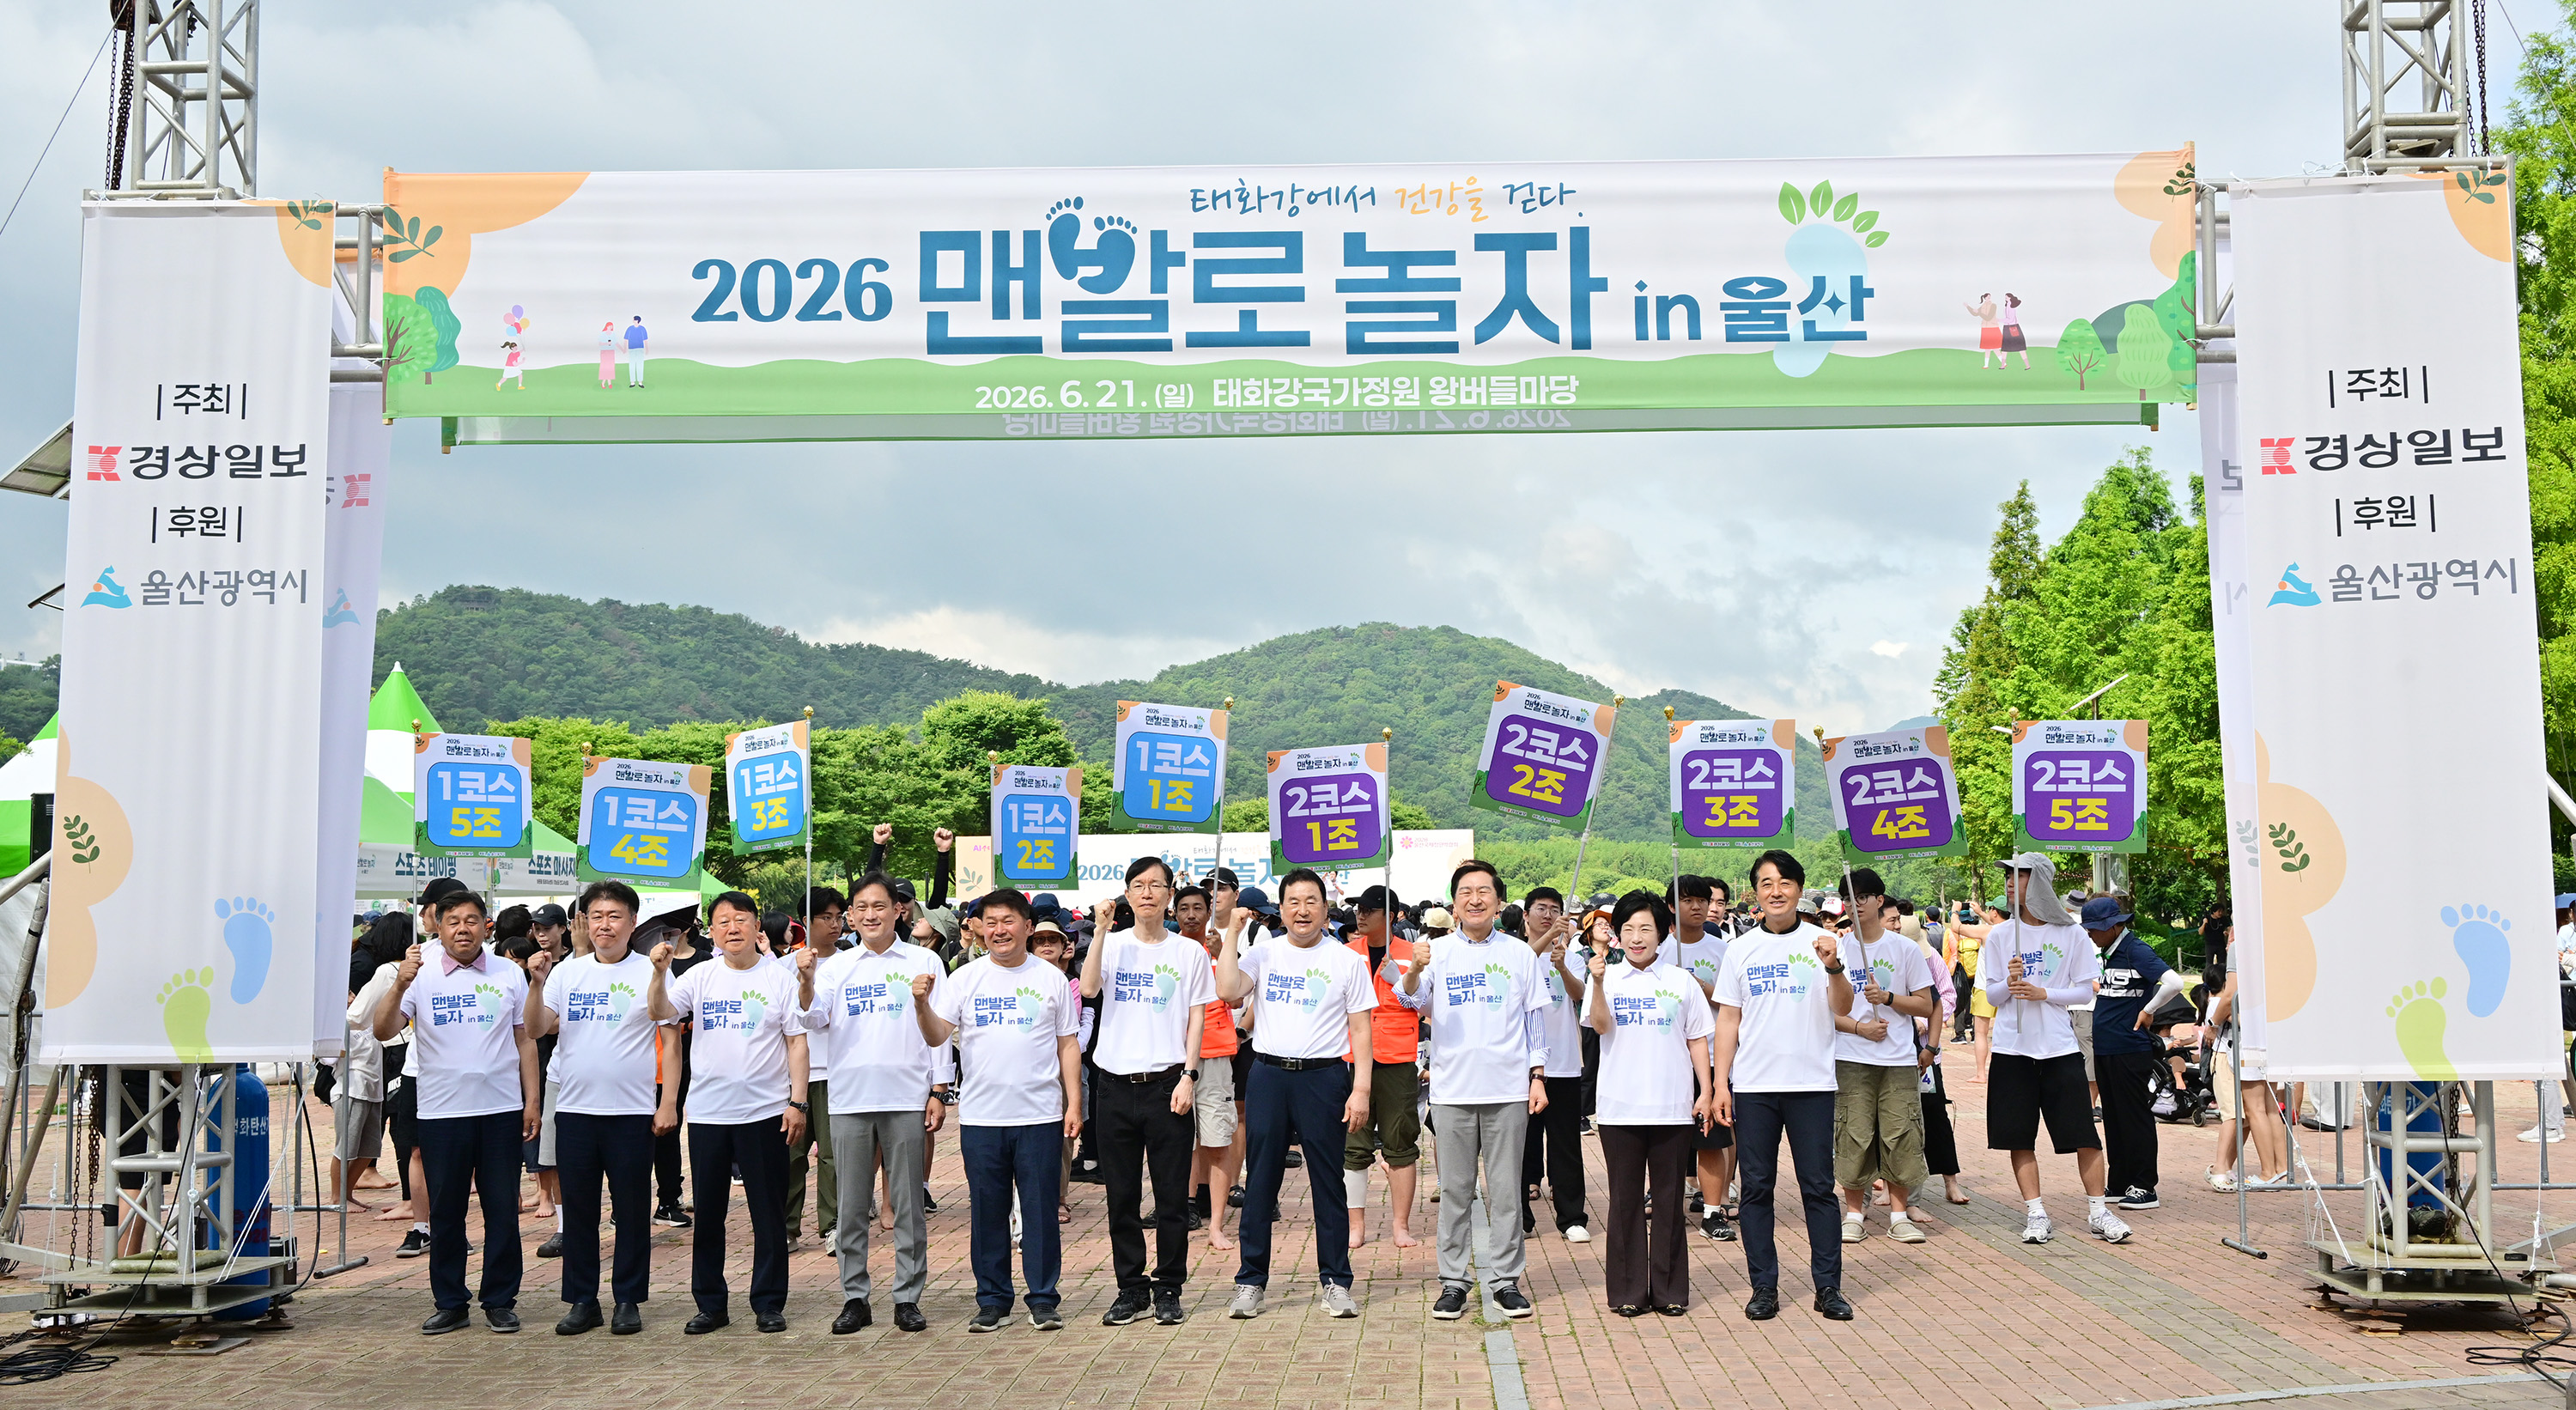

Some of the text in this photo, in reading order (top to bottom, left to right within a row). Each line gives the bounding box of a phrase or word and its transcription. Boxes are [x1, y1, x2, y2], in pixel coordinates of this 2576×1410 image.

[1189, 175, 1584, 222] 태화강에서 건강을 걷다.
[691, 195, 1874, 356] 2026 맨발로 놀자 in 울산
[173, 383, 231, 415] 주최
[975, 375, 1579, 409] 2026. 6. 21. (일) 태화강국가정원 왕버들마당
[2347, 367, 2409, 401] 주최
[129, 443, 307, 480] 경상일보
[2305, 426, 2506, 471] 경상일보
[167, 506, 227, 538] 후원
[2353, 495, 2416, 530] 후원
[140, 568, 307, 607] 울산광역시
[2329, 557, 2518, 603] 울산광역시
[1137, 741, 1210, 777] 1코스
[1502, 724, 1589, 772] 2코스
[438, 771, 515, 803] 1코스
[740, 760, 798, 797] 1코스
[1509, 764, 1567, 805] 2조
[1687, 757, 1775, 790] 2코스
[1846, 767, 1939, 805] 2코스
[2032, 759, 2126, 792] 2코스
[1149, 780, 1194, 811] 1조
[1285, 781, 1371, 817] 2코스
[1704, 795, 1759, 827] 3조
[449, 807, 501, 837] 5조
[605, 796, 688, 832] 1코스
[751, 797, 788, 831] 3조
[1008, 804, 1066, 834] 1코스
[1871, 805, 1930, 840] 4조
[2049, 799, 2108, 830] 5조
[1307, 818, 1358, 851] 1조
[528, 854, 552, 876] 스포츠
[611, 834, 669, 867] 4조
[1017, 840, 1054, 869] 2조
[1078, 864, 1125, 881] 2026
[1115, 972, 1153, 988] 맨발로
[1267, 973, 1305, 989] 맨발로
[1446, 973, 1486, 990] 맨발로
[1747, 963, 1789, 981] 맨발로
[432, 994, 477, 1010] 맨발로
[568, 993, 609, 1006] 맨발로
[845, 983, 886, 1000] 맨발로
[1115, 988, 1142, 1002] 놀자
[1266, 988, 1291, 1003] 놀자
[1449, 990, 1475, 1006] 놀자
[1750, 980, 1777, 996] 놀자
[433, 1010, 464, 1025] 놀자
[568, 1008, 595, 1021] 놀자
[702, 1000, 742, 1015] 맨발로
[848, 1000, 875, 1016] 놀자
[975, 997, 1017, 1011] 맨발로
[975, 1012, 1004, 1026] 놀자
[1614, 998, 1656, 1010] 맨발로
[1616, 1012, 1643, 1025] 놀자
[703, 1015, 728, 1030] 놀자
